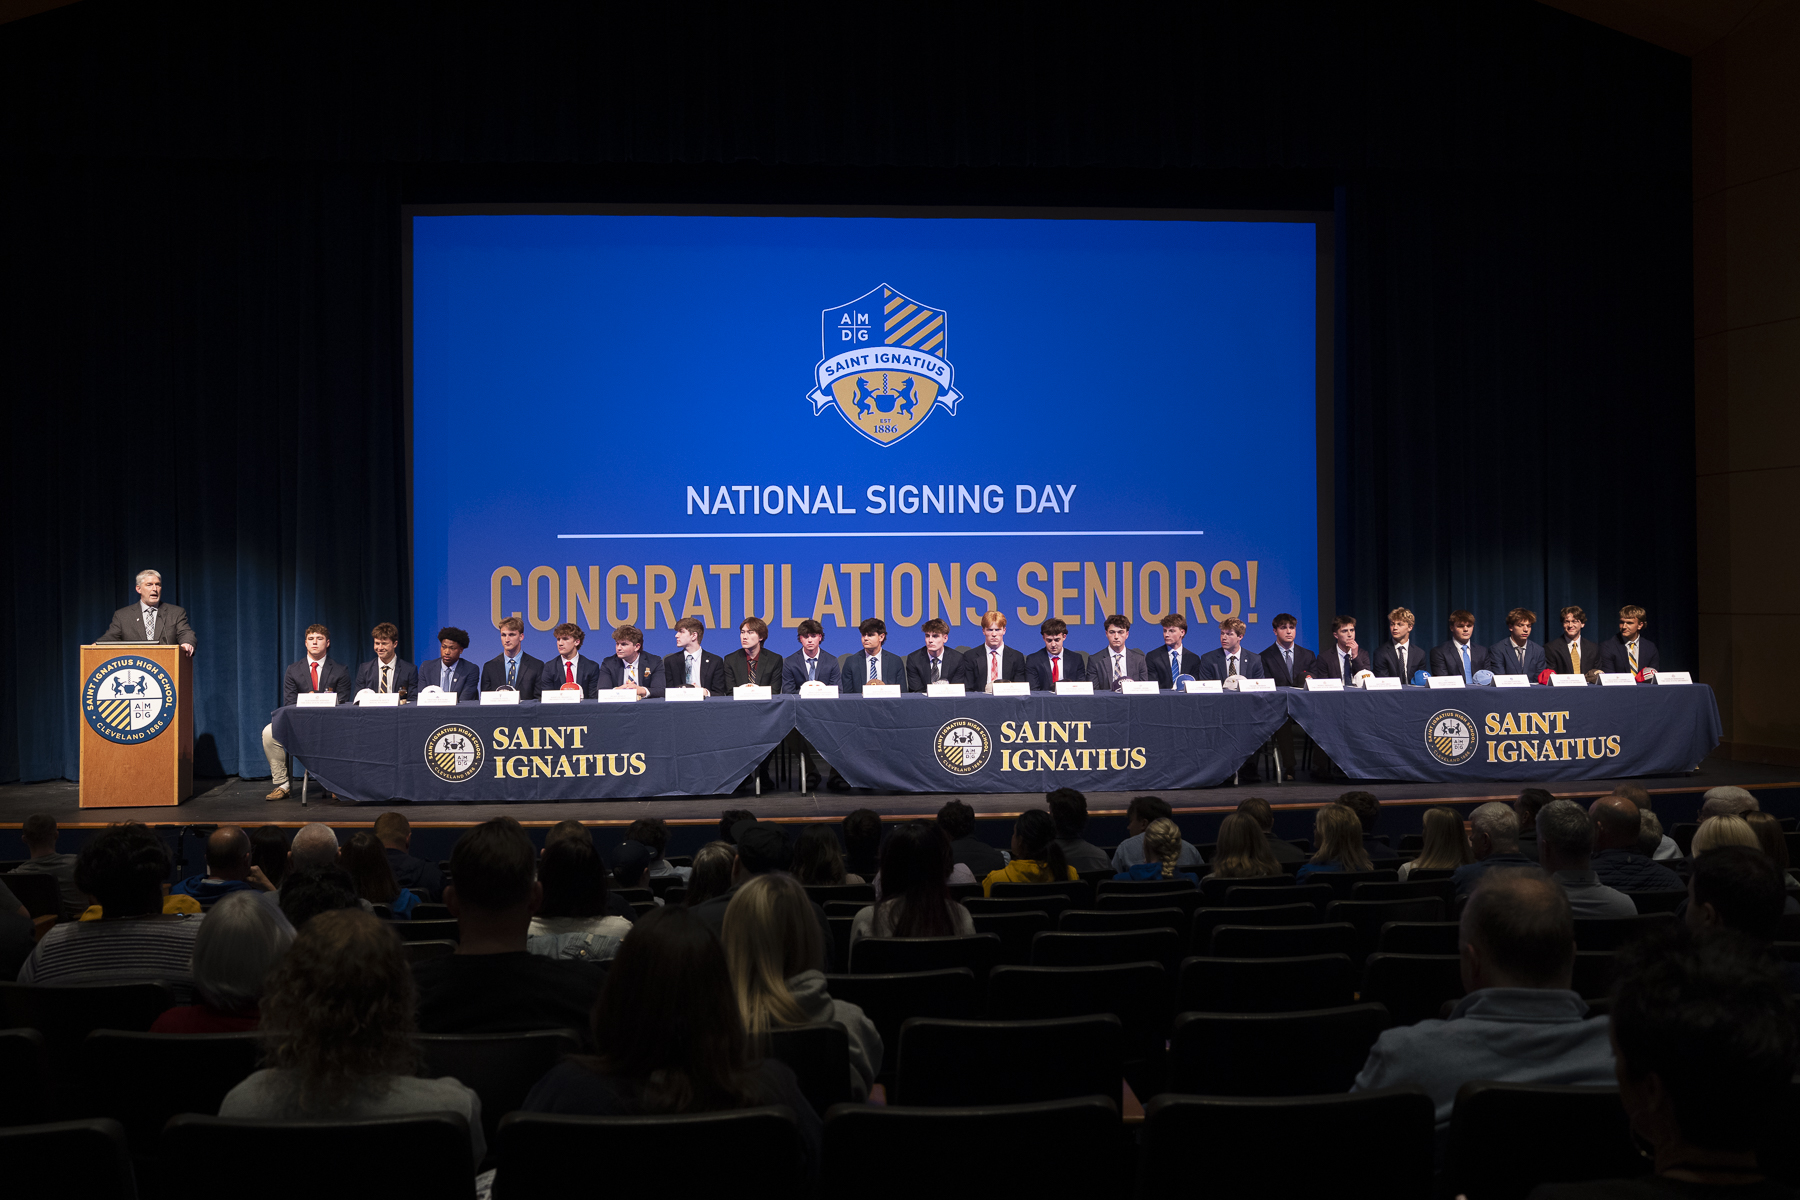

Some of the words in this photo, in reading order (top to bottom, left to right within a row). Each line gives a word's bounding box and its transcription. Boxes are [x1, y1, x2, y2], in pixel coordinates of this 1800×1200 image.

[825, 354, 869, 377] SAINT
[875, 353, 945, 377] IGNATIUS
[873, 424, 898, 434] 1886
[686, 484, 856, 515] NATIONAL
[865, 484, 1004, 514] SIGNING
[1015, 484, 1077, 514] DAY
[491, 562, 997, 631] CONGRATULATIONS
[1016, 560, 1258, 627] SENIORS!
[86, 683, 96, 711] SAINT
[93, 659, 134, 682] IGNATIUS
[136, 659, 159, 675] HIGH
[157, 673, 173, 708] SCHOOL
[96, 722, 145, 740] CLEVELAND
[146, 720, 164, 735] 1886
[1000, 720, 1091, 744] SAINT
[1432, 712, 1454, 726] IGNATIUS
[1454, 713, 1467, 722] HIGH
[1466, 722, 1476, 744] SCHOOL
[1484, 710, 1569, 735] SAINT
[432, 727, 457, 742] IGNATIUS
[458, 727, 472, 738] HIGH
[471, 736, 482, 760] SCHOOL
[493, 725, 588, 750] SAINT
[942, 721, 966, 735] IGNATIUS
[967, 722, 981, 732] HIGH
[979, 730, 989, 753] SCHOOL
[1486, 735, 1621, 763] IGNATIUS
[493, 752, 647, 779] IGNATIUS
[942, 759, 972, 772] CLEVELAND
[1000, 747, 1147, 772] IGNATIUS
[1433, 750, 1460, 762] CLEVELAND
[434, 766, 465, 779] CLEVELAND
